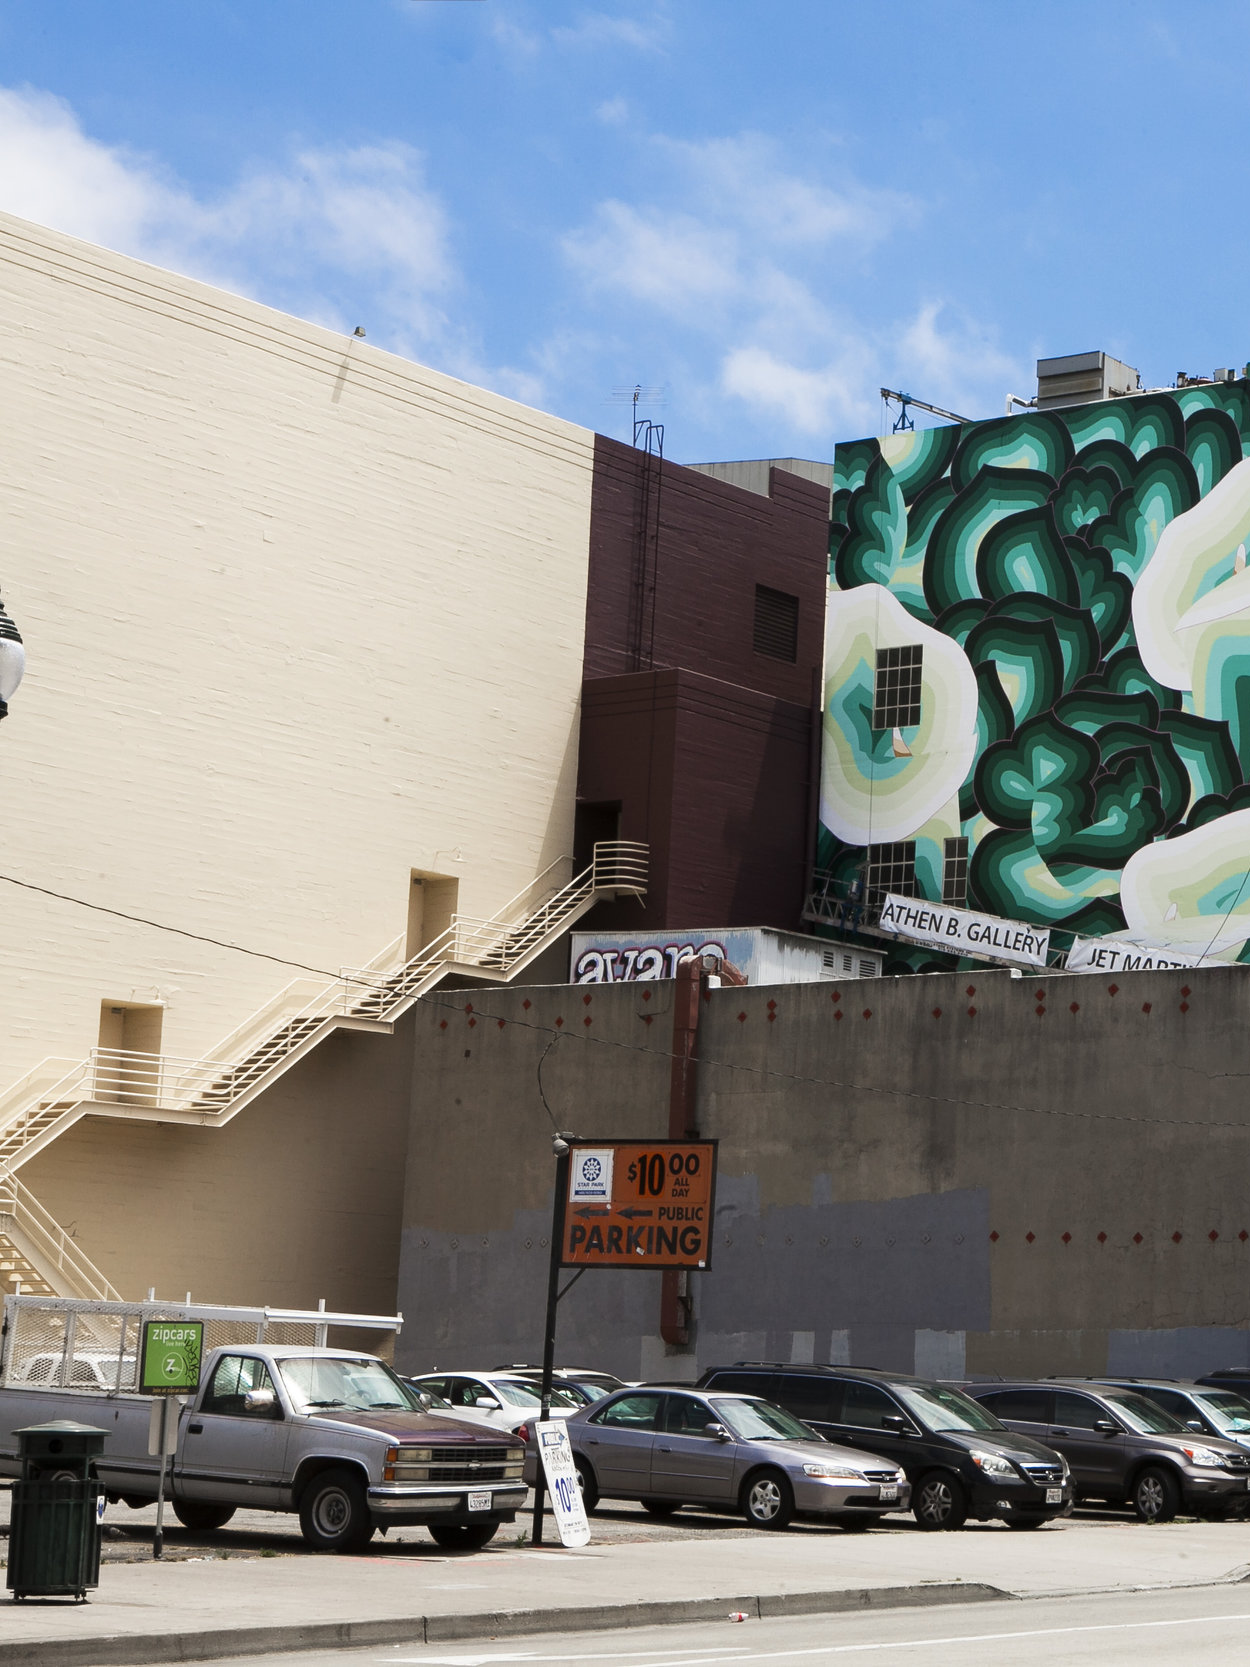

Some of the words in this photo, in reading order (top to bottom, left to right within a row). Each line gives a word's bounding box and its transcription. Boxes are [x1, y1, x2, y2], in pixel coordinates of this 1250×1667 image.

[882, 903, 943, 933] ATHEN
[946, 918, 962, 938] B.
[967, 923, 1047, 956] GALLERY
[1087, 948, 1120, 970] JET
[674, 1178, 690, 1187] ALL
[671, 1188, 690, 1198] DAY
[658, 1207, 704, 1221] PUBLIC
[569, 1225, 701, 1255] PARKING
[152, 1325, 196, 1344] zipcars
